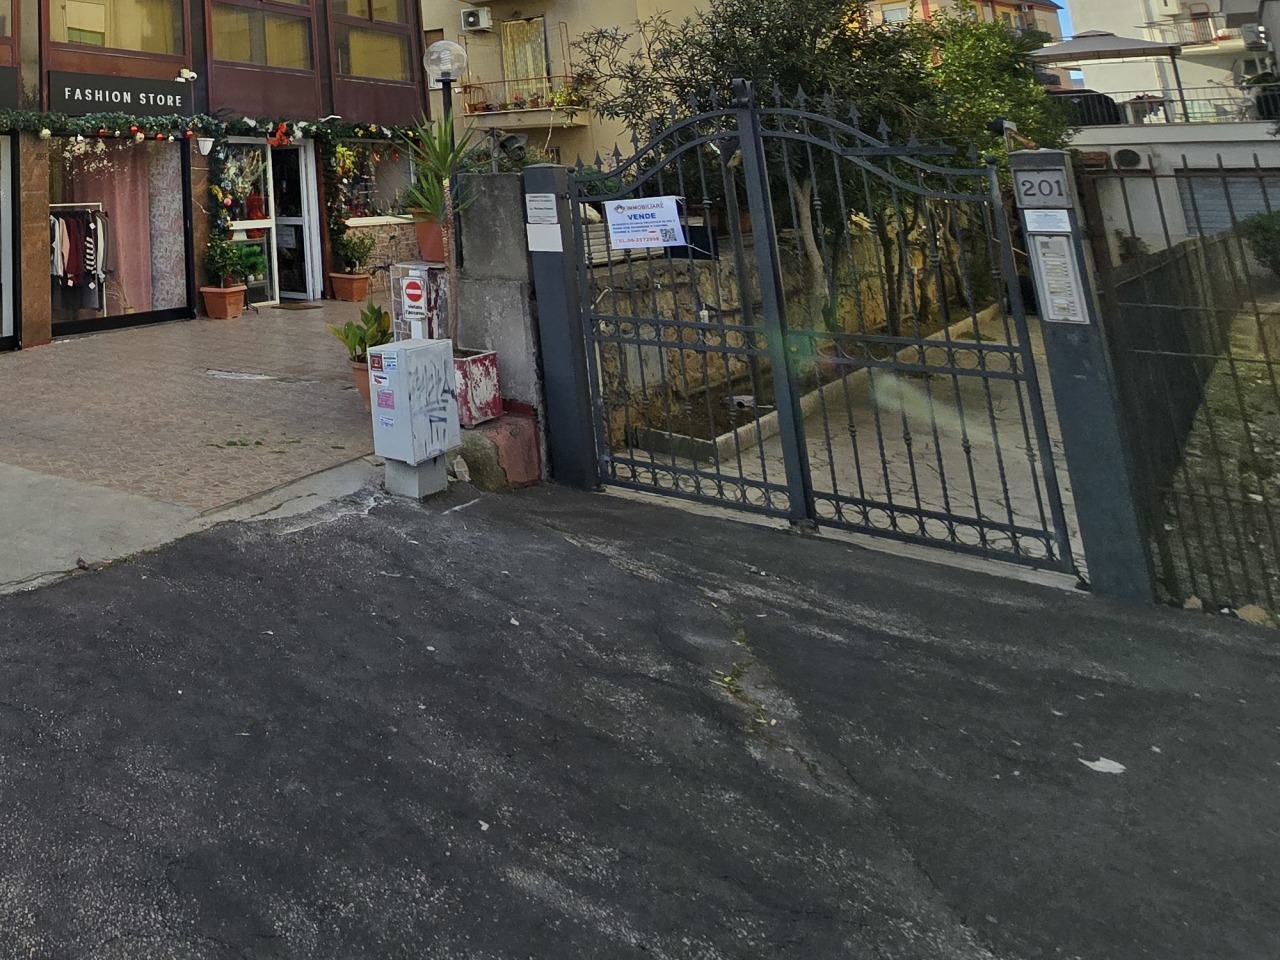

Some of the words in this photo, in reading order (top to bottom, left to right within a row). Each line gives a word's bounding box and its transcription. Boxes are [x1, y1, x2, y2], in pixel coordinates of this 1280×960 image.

[64, 87, 131, 103] FASHION
[139, 93, 182, 107] STORE
[1021, 179, 1064, 197] 201
[627, 212, 657, 220] VENDE
